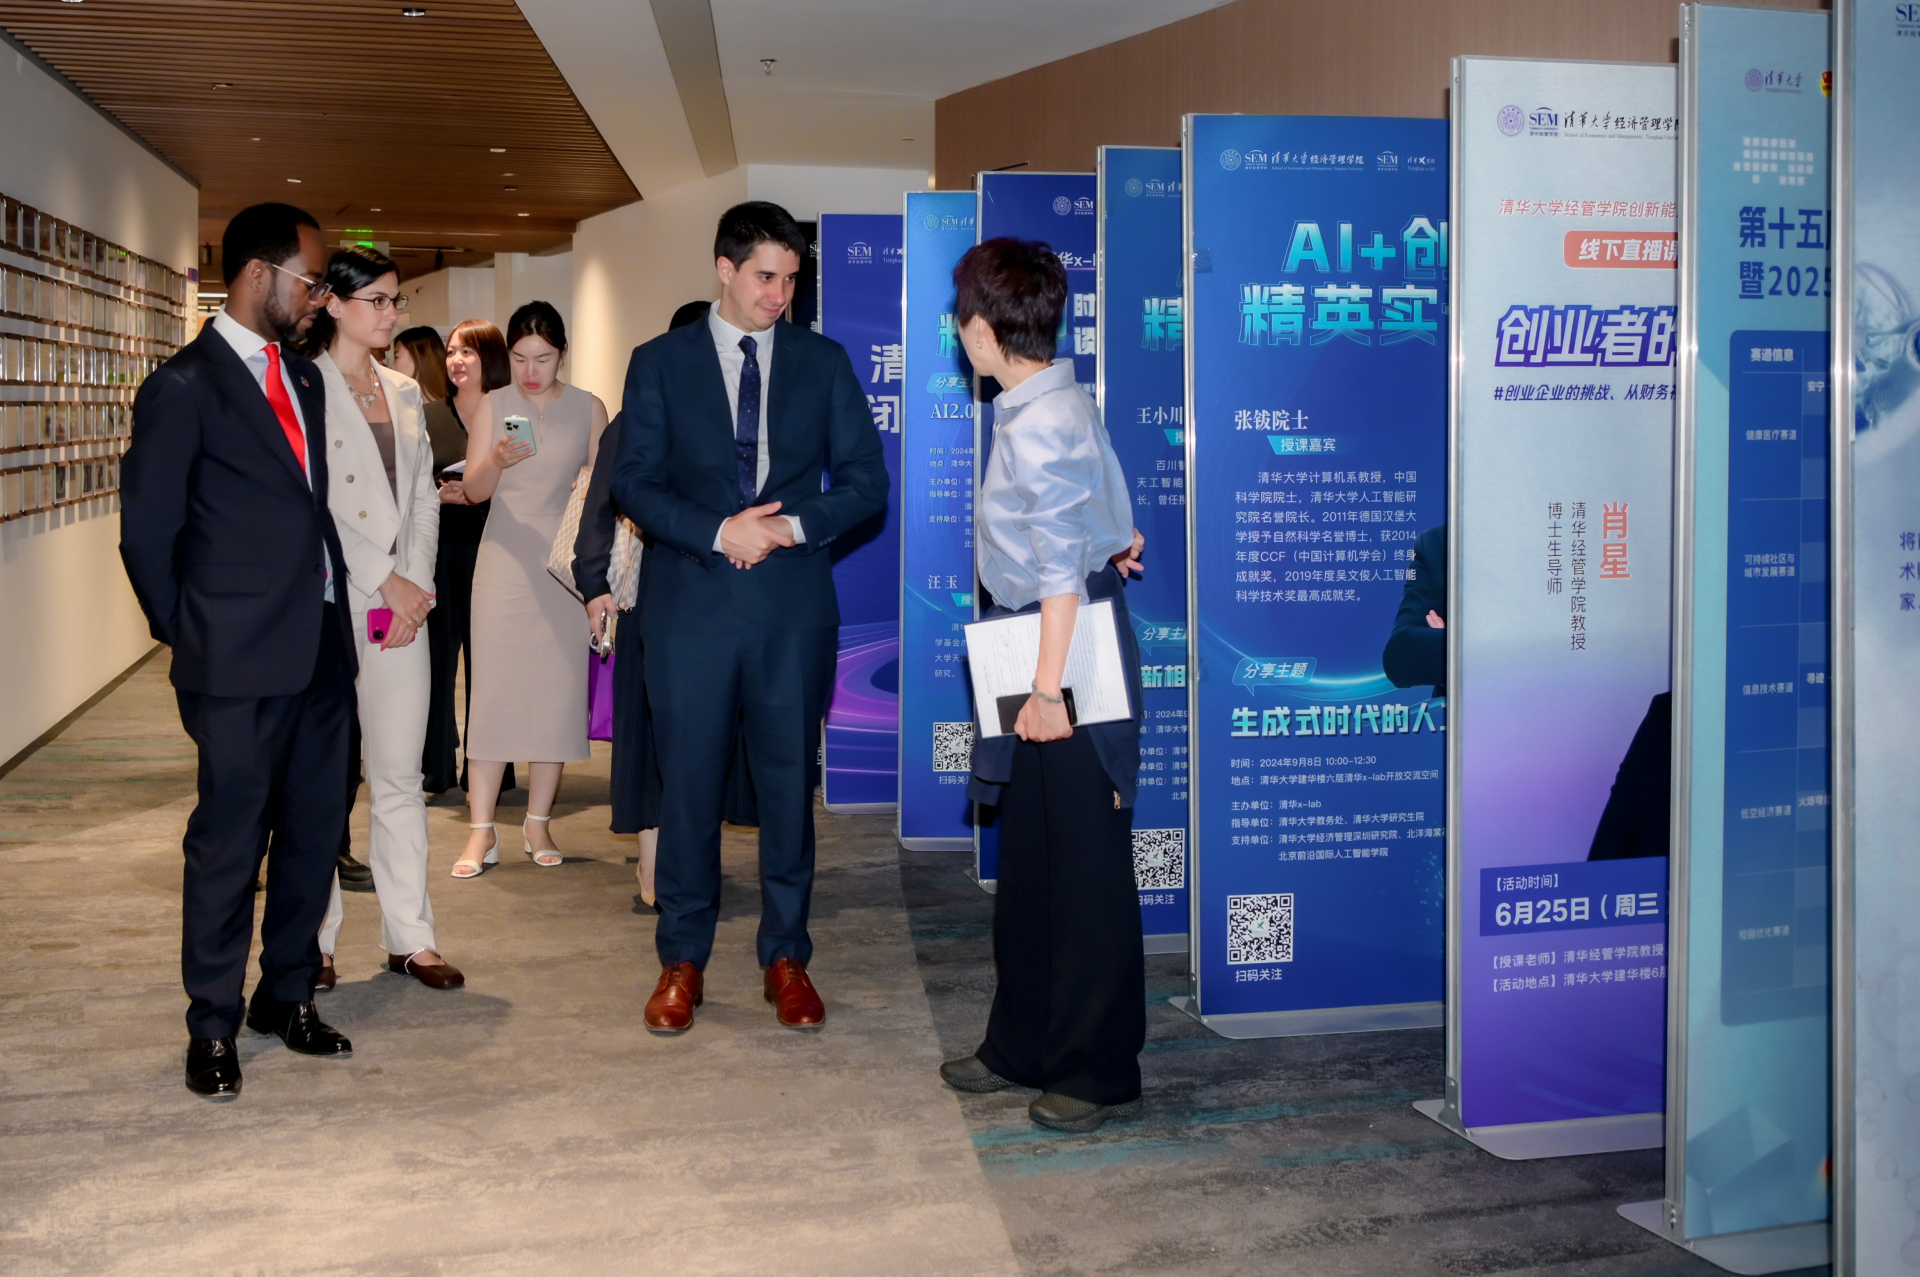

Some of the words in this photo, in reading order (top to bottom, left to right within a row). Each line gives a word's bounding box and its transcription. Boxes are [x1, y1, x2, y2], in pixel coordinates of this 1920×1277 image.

[1529, 112, 1559, 126] SEM
[1245, 153, 1267, 163] SEM
[1377, 155, 1398, 165] SEM
[1145, 182, 1165, 191] SEM
[1074, 200, 1094, 209] SEM
[1498, 199, 1679, 218] 清华大学经管学院创新能
[942, 217, 958, 226] SEM
[1739, 206, 1831, 250] 第十五
[847, 245, 872, 257] SEM
[1579, 238, 1679, 261] 线下直播课
[1239, 281, 1438, 346] 精英实
[871, 344, 902, 384] 清
[930, 403, 974, 419] AI2.0
[1136, 406, 1183, 425] 王小川
[1235, 409, 1309, 431] 张钹院士
[1281, 438, 1336, 452] 授课嘉宾
[1547, 502, 1562, 595] 博士生导师
[1599, 501, 1631, 579] 肖星
[1900, 531, 1920, 551] 将
[1571, 502, 1586, 650] 清华经管学院教授
[1900, 562, 1920, 581] 术
[1235, 589, 1362, 602] 科学技术奖最高成就奖。
[1900, 592, 1920, 612] 家
[1243, 662, 1308, 680] 分享主题
[1278, 847, 1388, 861] 北京前沿国际人工智能学院
[1497, 873, 1559, 892] 【活动时间】
[1235, 968, 1283, 983] 扫码关注
